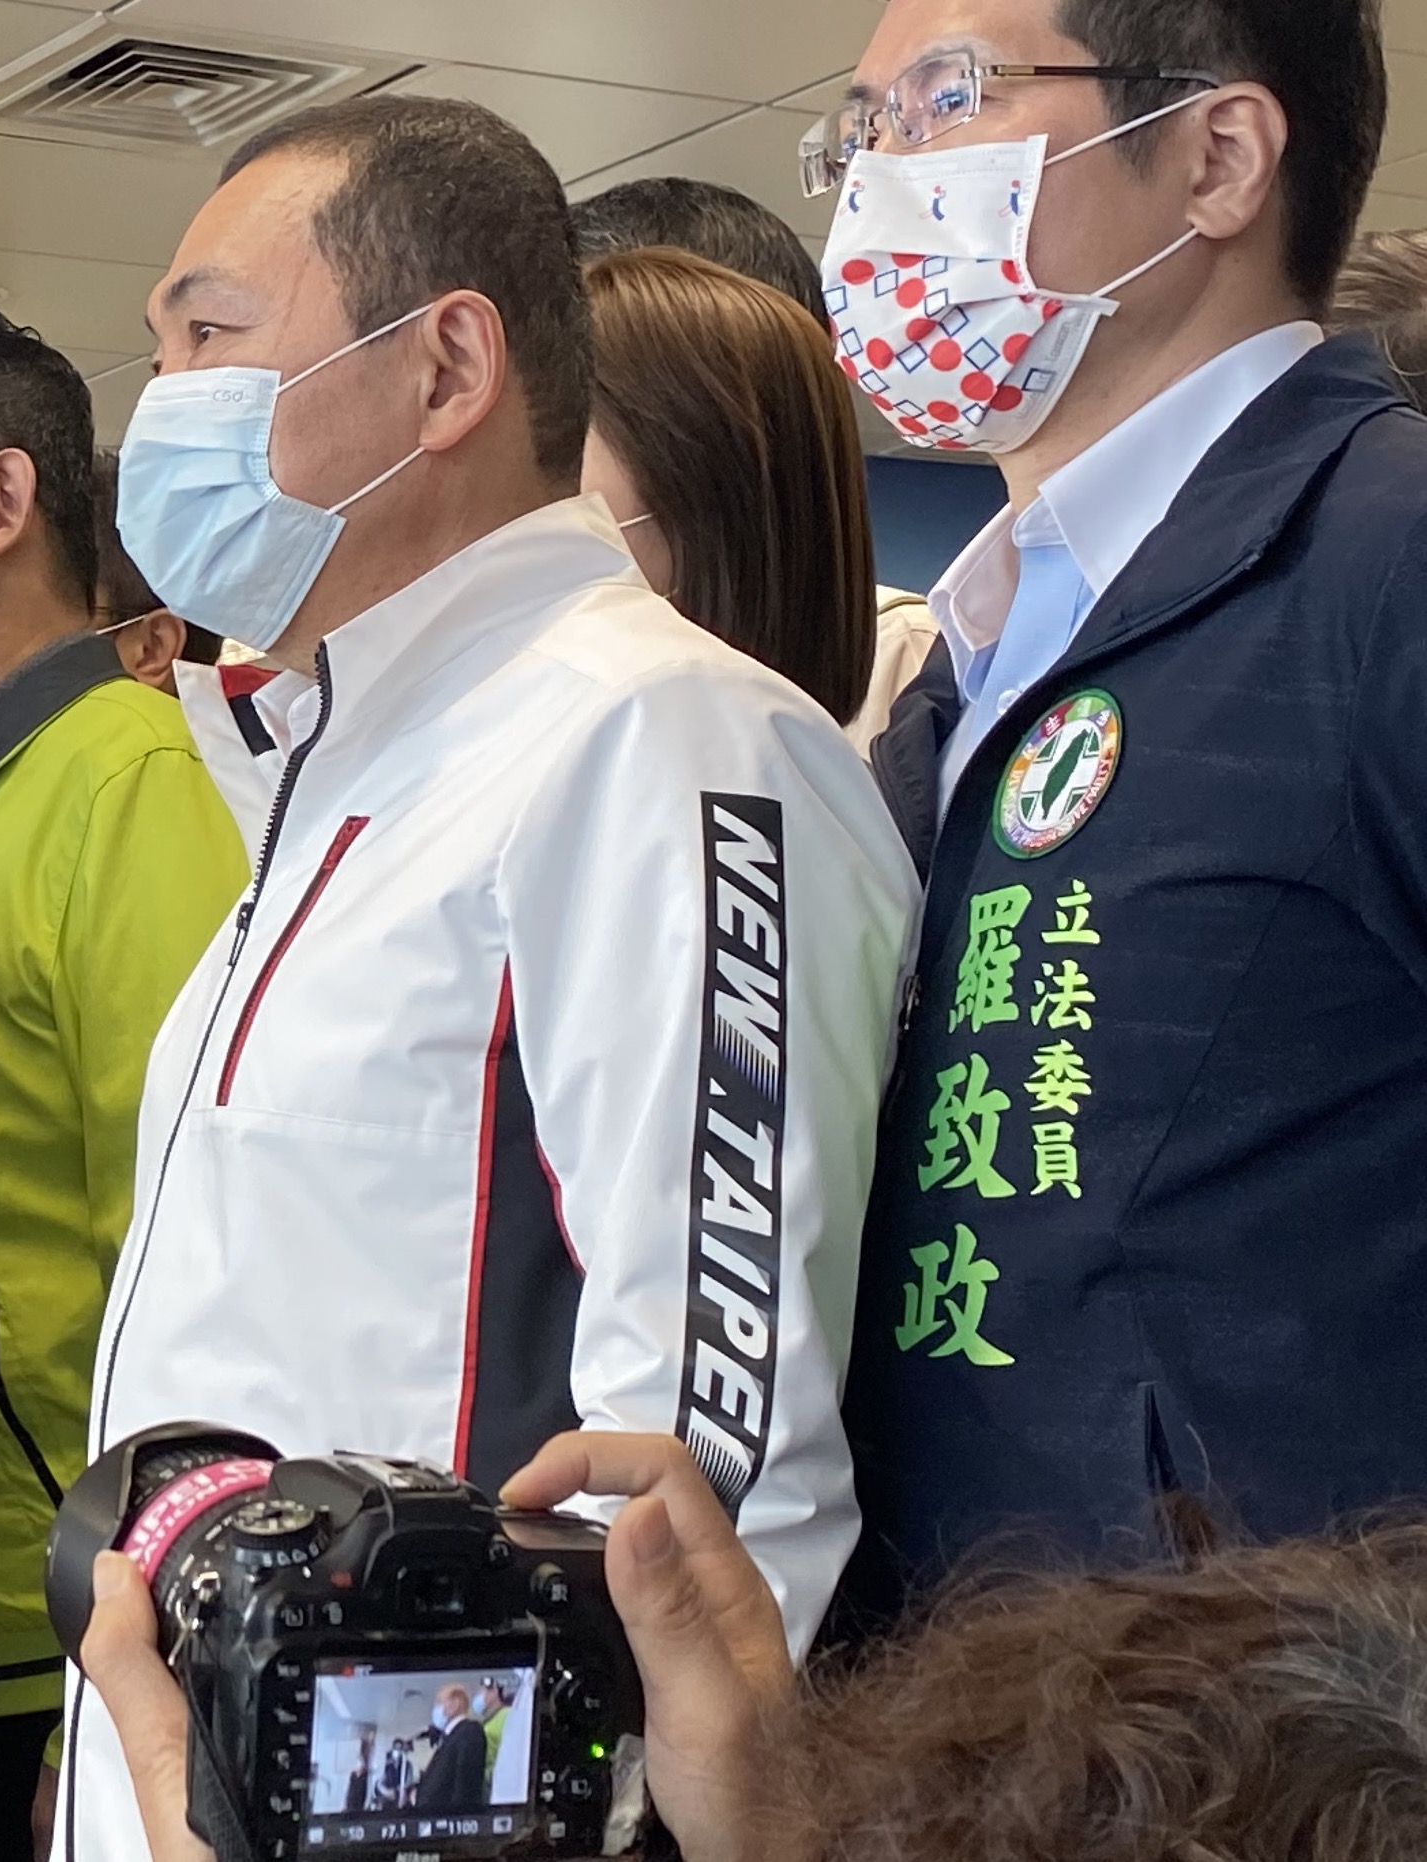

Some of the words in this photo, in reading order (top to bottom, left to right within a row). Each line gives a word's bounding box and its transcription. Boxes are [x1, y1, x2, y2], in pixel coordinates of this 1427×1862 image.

[713, 804, 780, 1085] NEW
[1023, 879, 1100, 1200] 立法委員
[686, 1107, 775, 1485] TAIPEI
[894, 884, 1033, 1367] 羅致政
